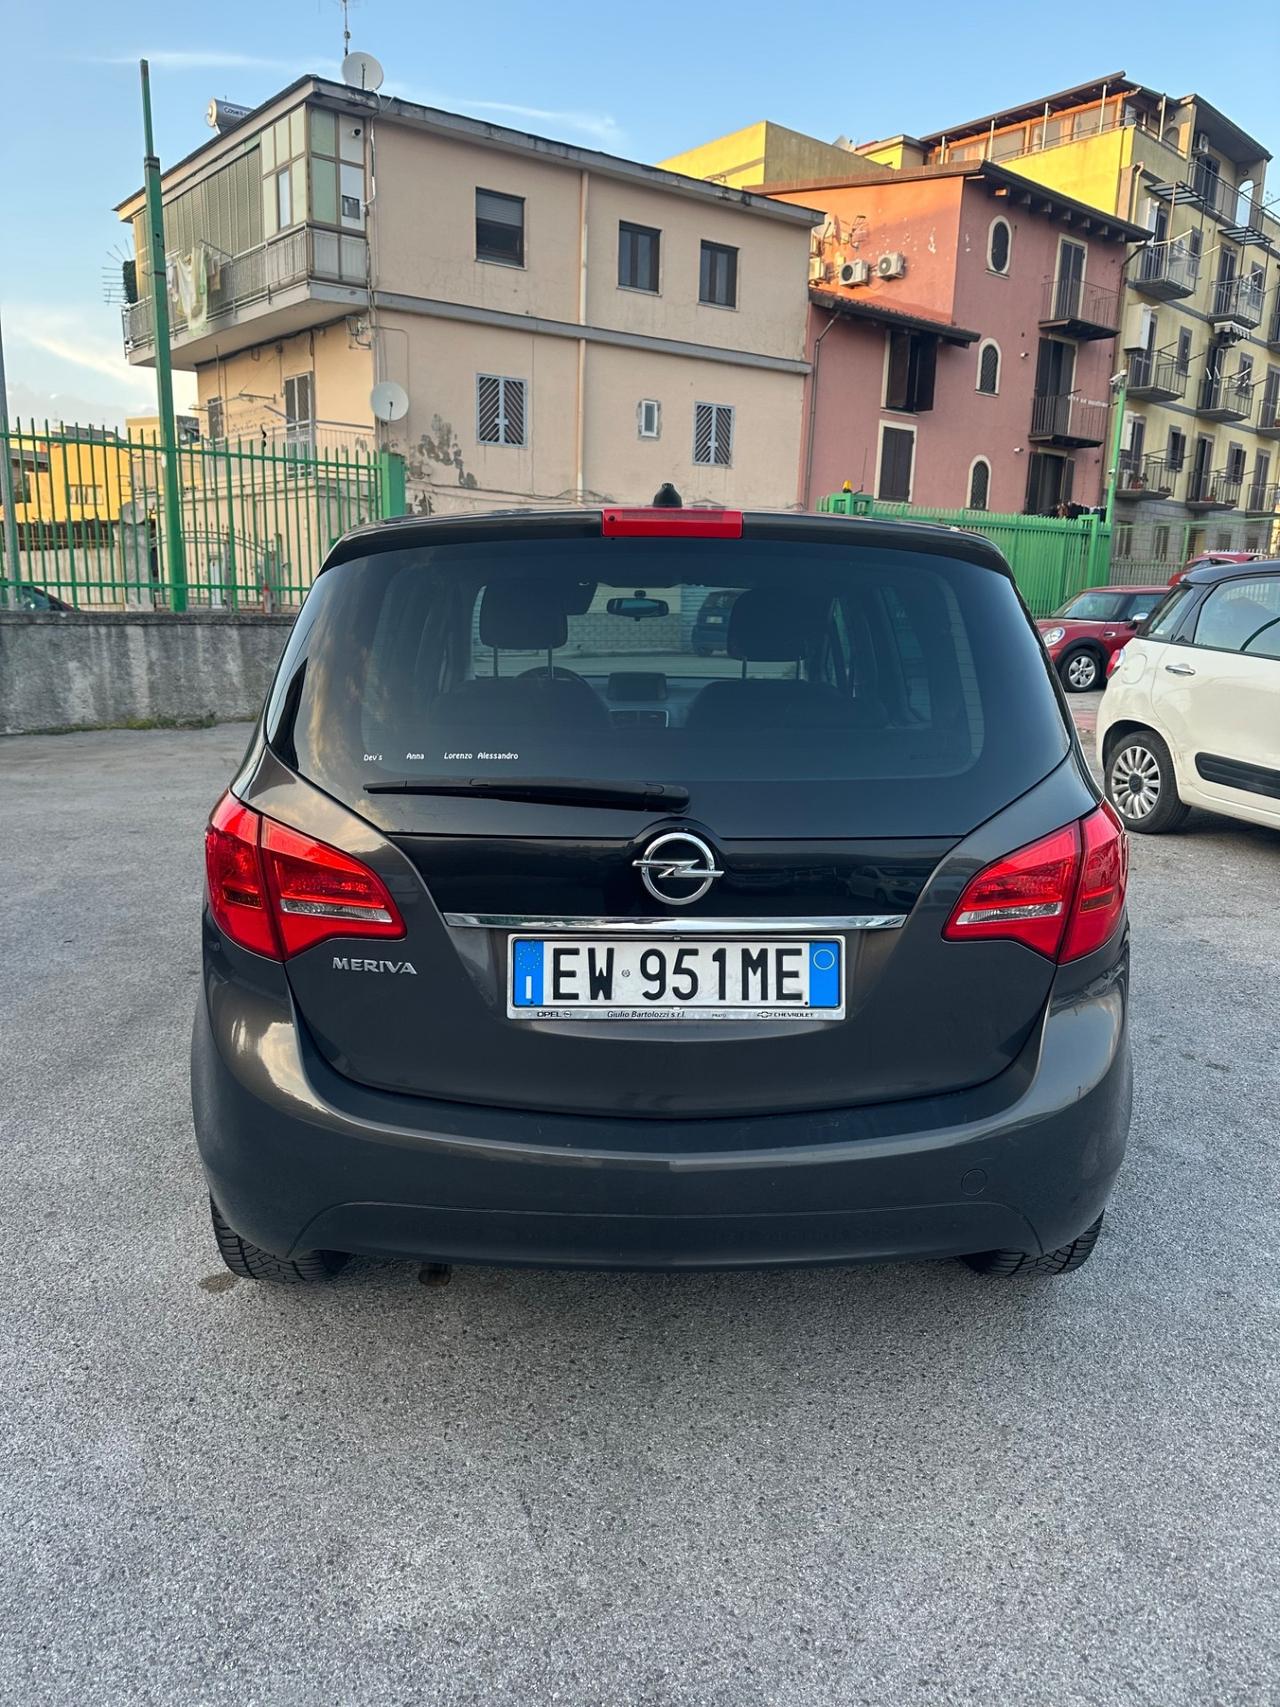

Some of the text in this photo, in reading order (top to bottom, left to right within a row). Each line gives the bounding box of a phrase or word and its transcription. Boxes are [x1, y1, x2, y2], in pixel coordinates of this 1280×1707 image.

[363, 752, 519, 762] Dev's Anna Lorenzo Alessandro
[332, 957, 418, 975] MERIVA
[552, 947, 615, 1001] EW
[606, 1010, 630, 1018] Giulio
[631, 1010, 669, 1019] Bartolozzi
